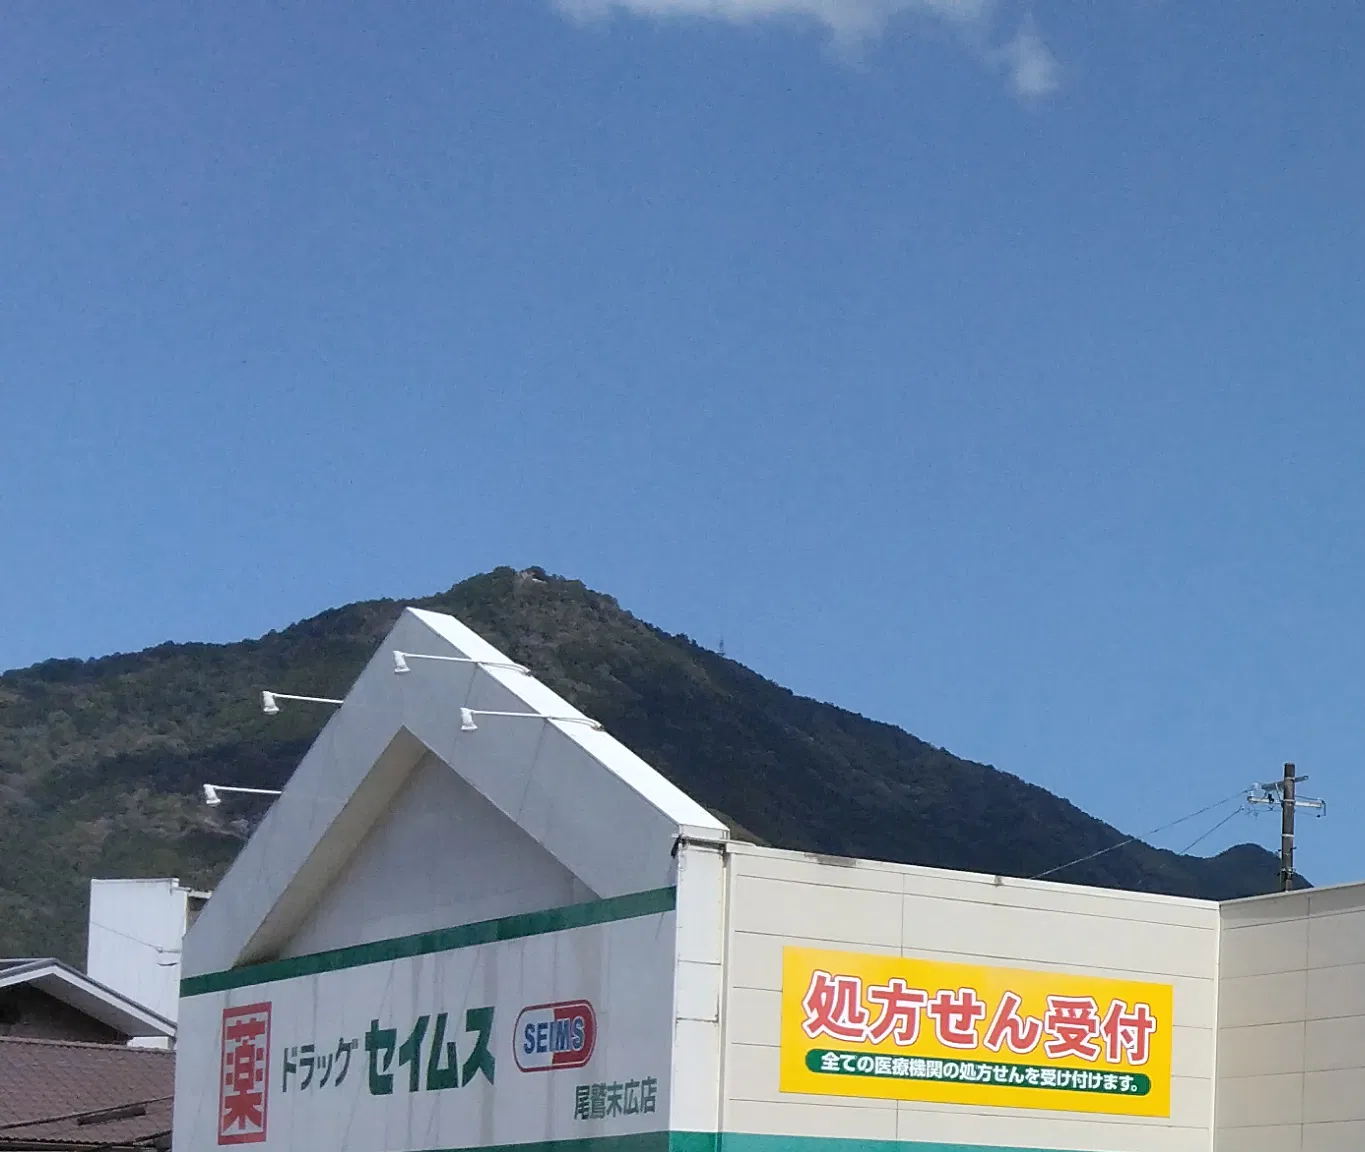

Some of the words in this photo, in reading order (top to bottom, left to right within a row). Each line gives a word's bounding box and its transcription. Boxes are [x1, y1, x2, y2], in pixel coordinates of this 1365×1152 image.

[282, 1038, 358, 1092] ドラッグ
[364, 1006, 496, 1096] セイムス
[523, 1016, 585, 1054] SEIMS
[802, 969, 1157, 1066] 処方せん受付
[223, 1017, 267, 1133] 薬
[574, 1076, 658, 1121] 尾鷲末広店
[821, 1051, 1138, 1092] 全ての医療機関の処方せんを受け付けます。
